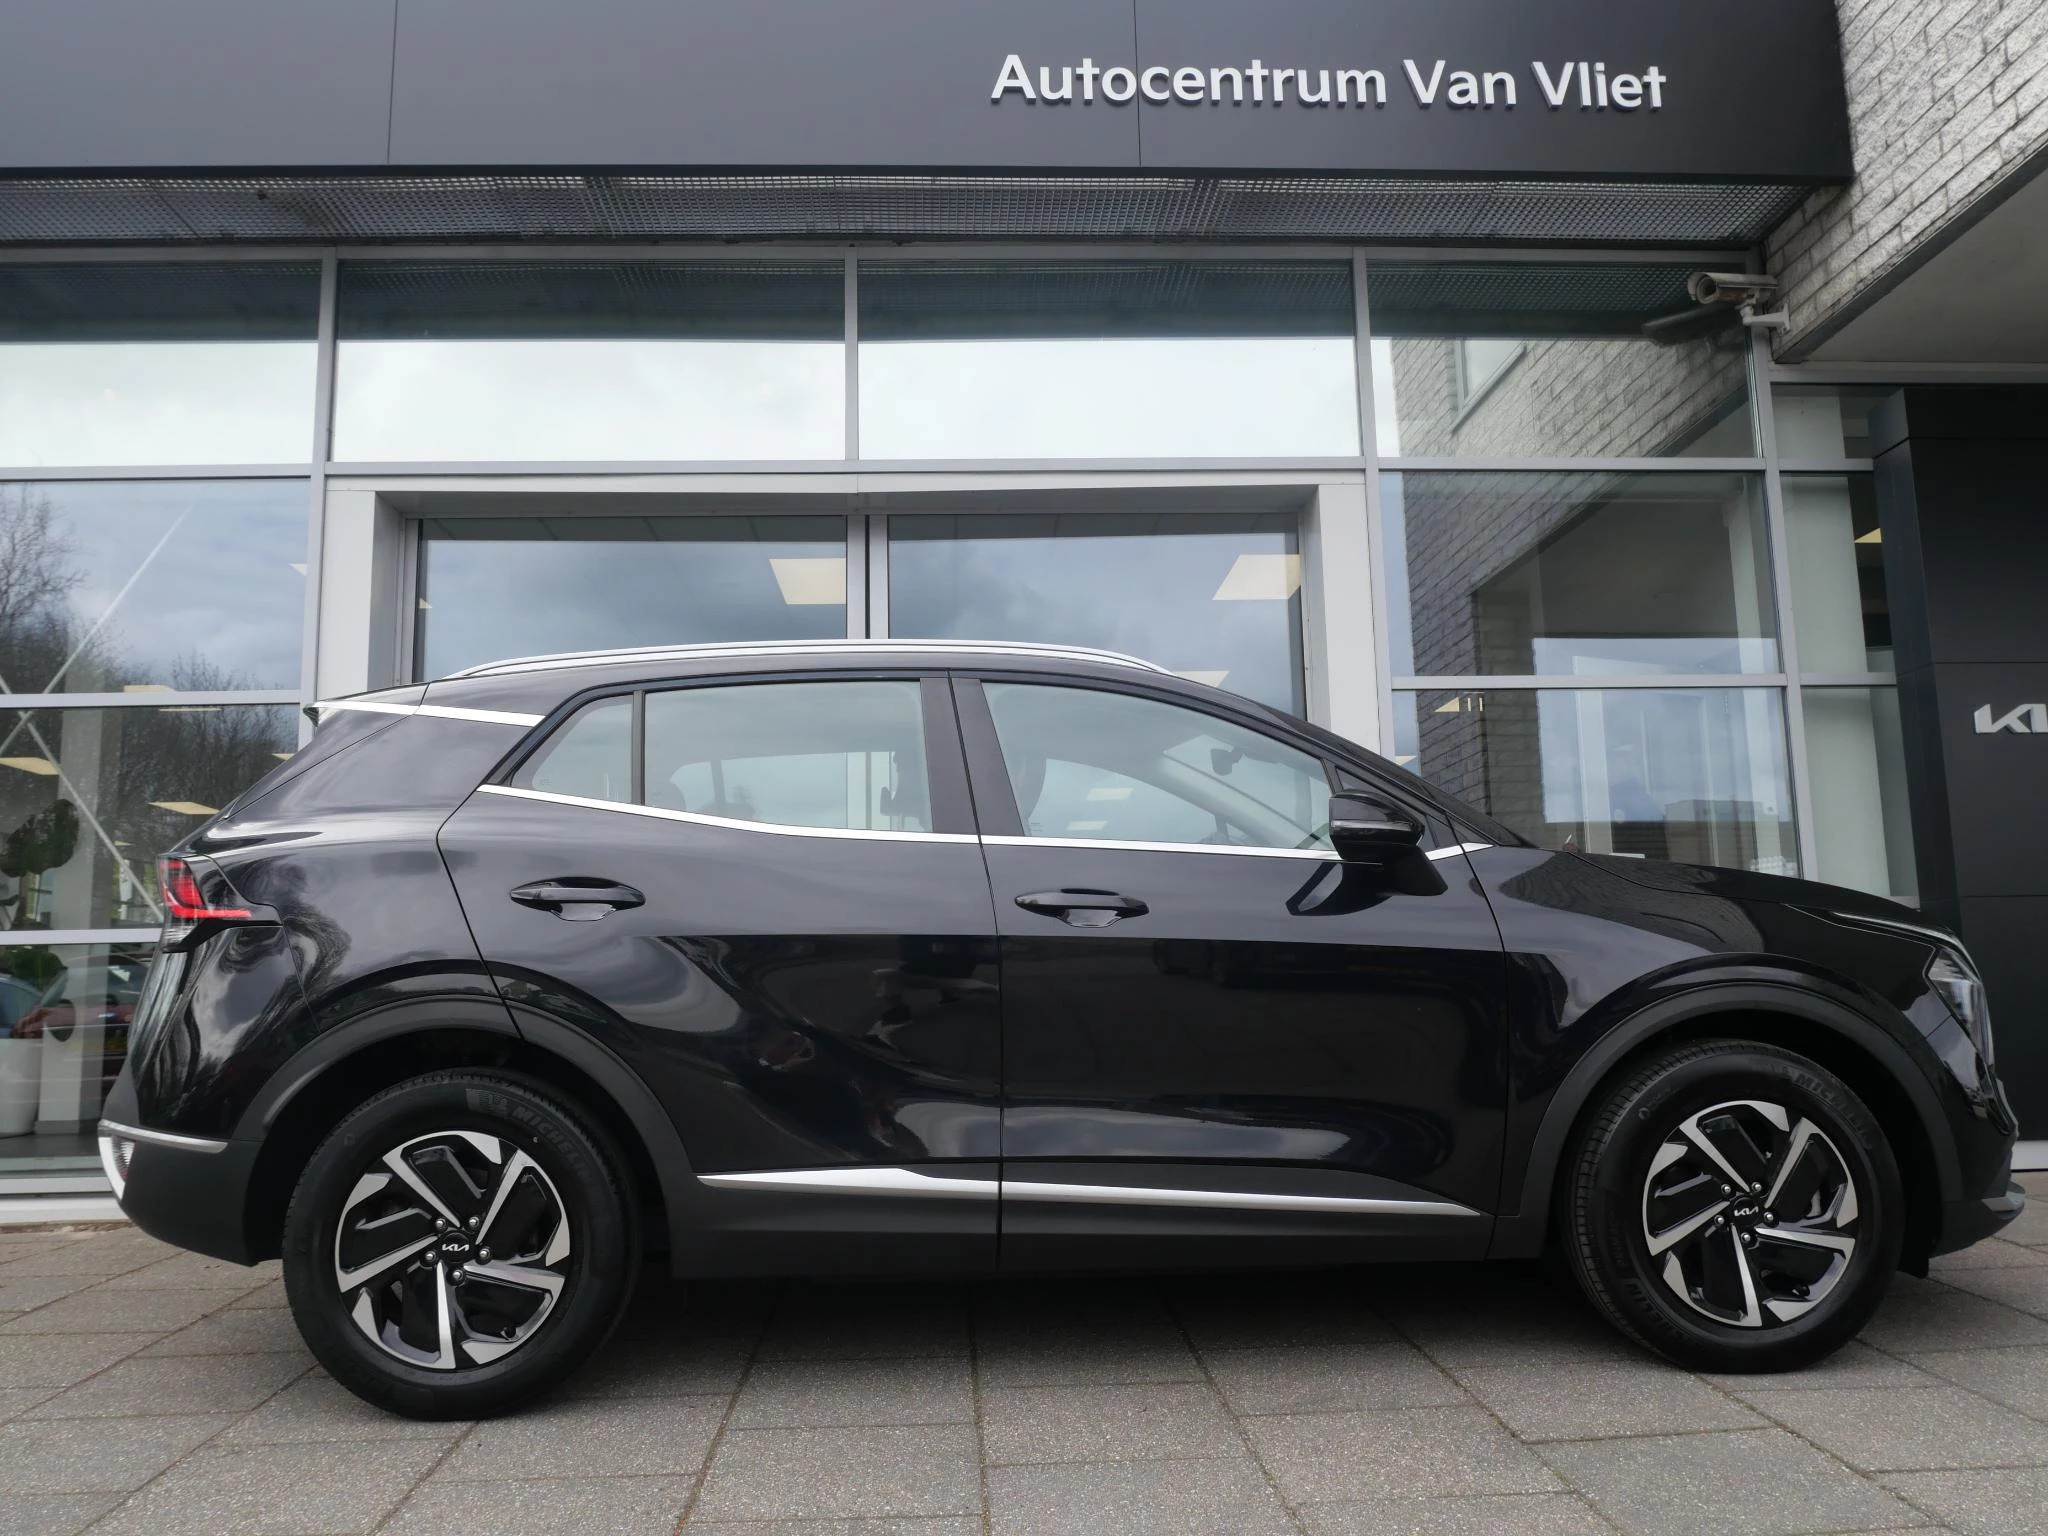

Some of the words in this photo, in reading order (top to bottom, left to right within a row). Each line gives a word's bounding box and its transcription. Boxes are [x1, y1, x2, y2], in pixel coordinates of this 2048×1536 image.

[990, 54, 1387, 106] Autocentrum
[1402, 59, 1517, 109] Van
[1530, 61, 1667, 112] Vliet
[511, 1105, 593, 1181] MICHELIN
[441, 1243, 470, 1252] KIA
